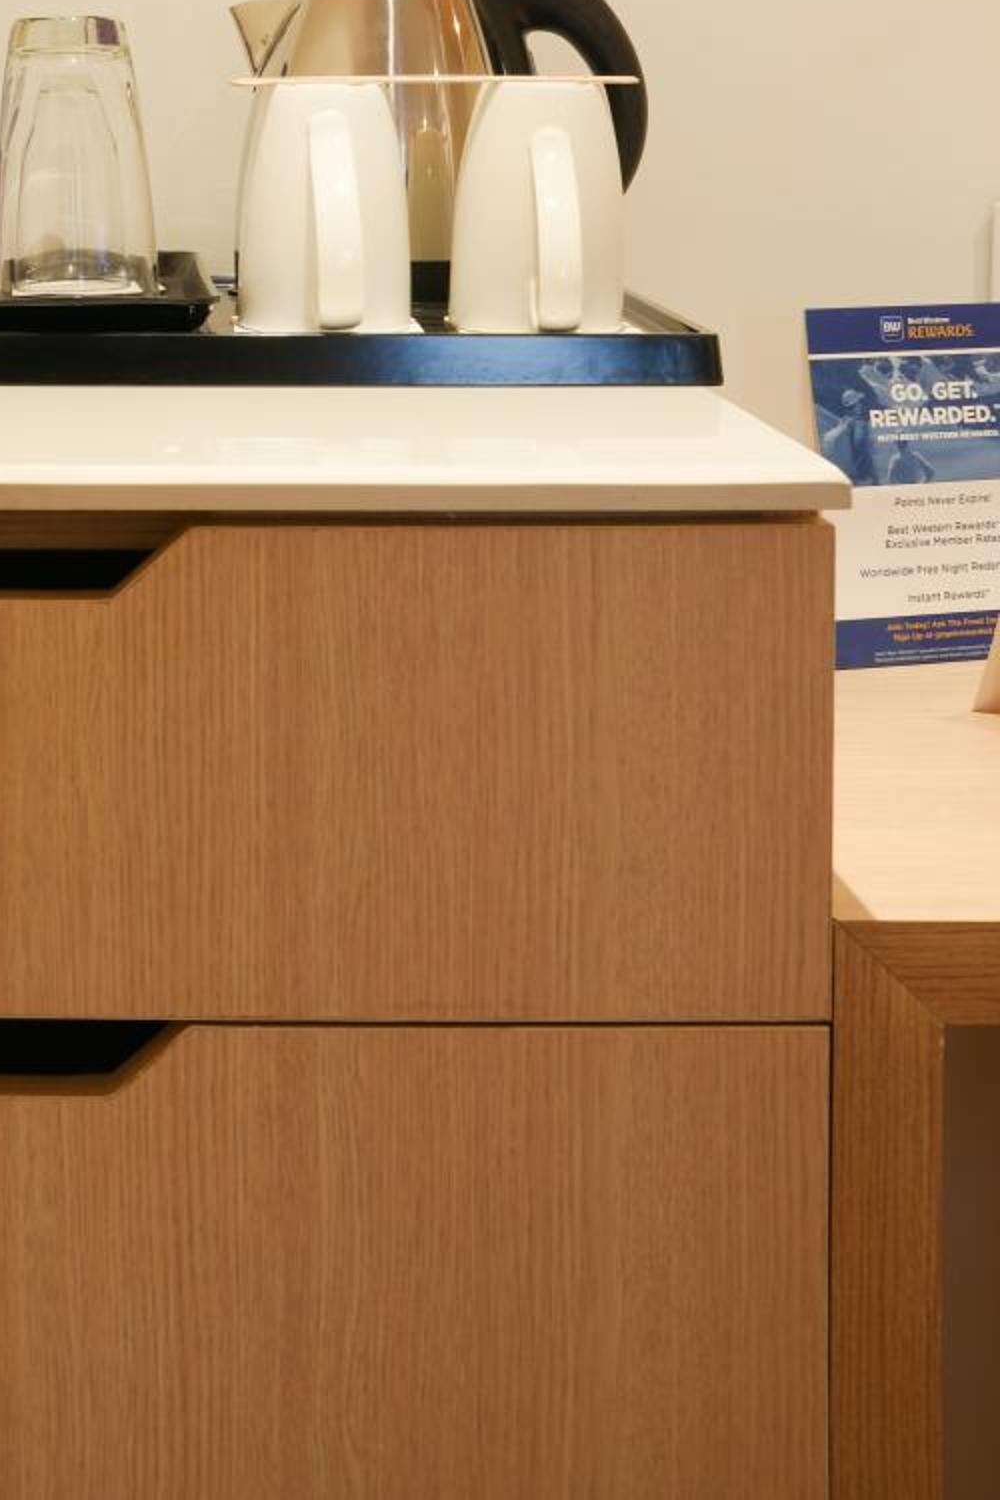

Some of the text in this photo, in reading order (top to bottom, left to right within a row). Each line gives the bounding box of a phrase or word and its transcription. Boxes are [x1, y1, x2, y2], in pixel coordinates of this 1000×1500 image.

[907, 324, 974, 340] REWARDS
[890, 381, 978, 402] GO. GET.
[927, 496, 955, 505] Never
[887, 525, 909, 535] Best
[911, 522, 952, 533] Western
